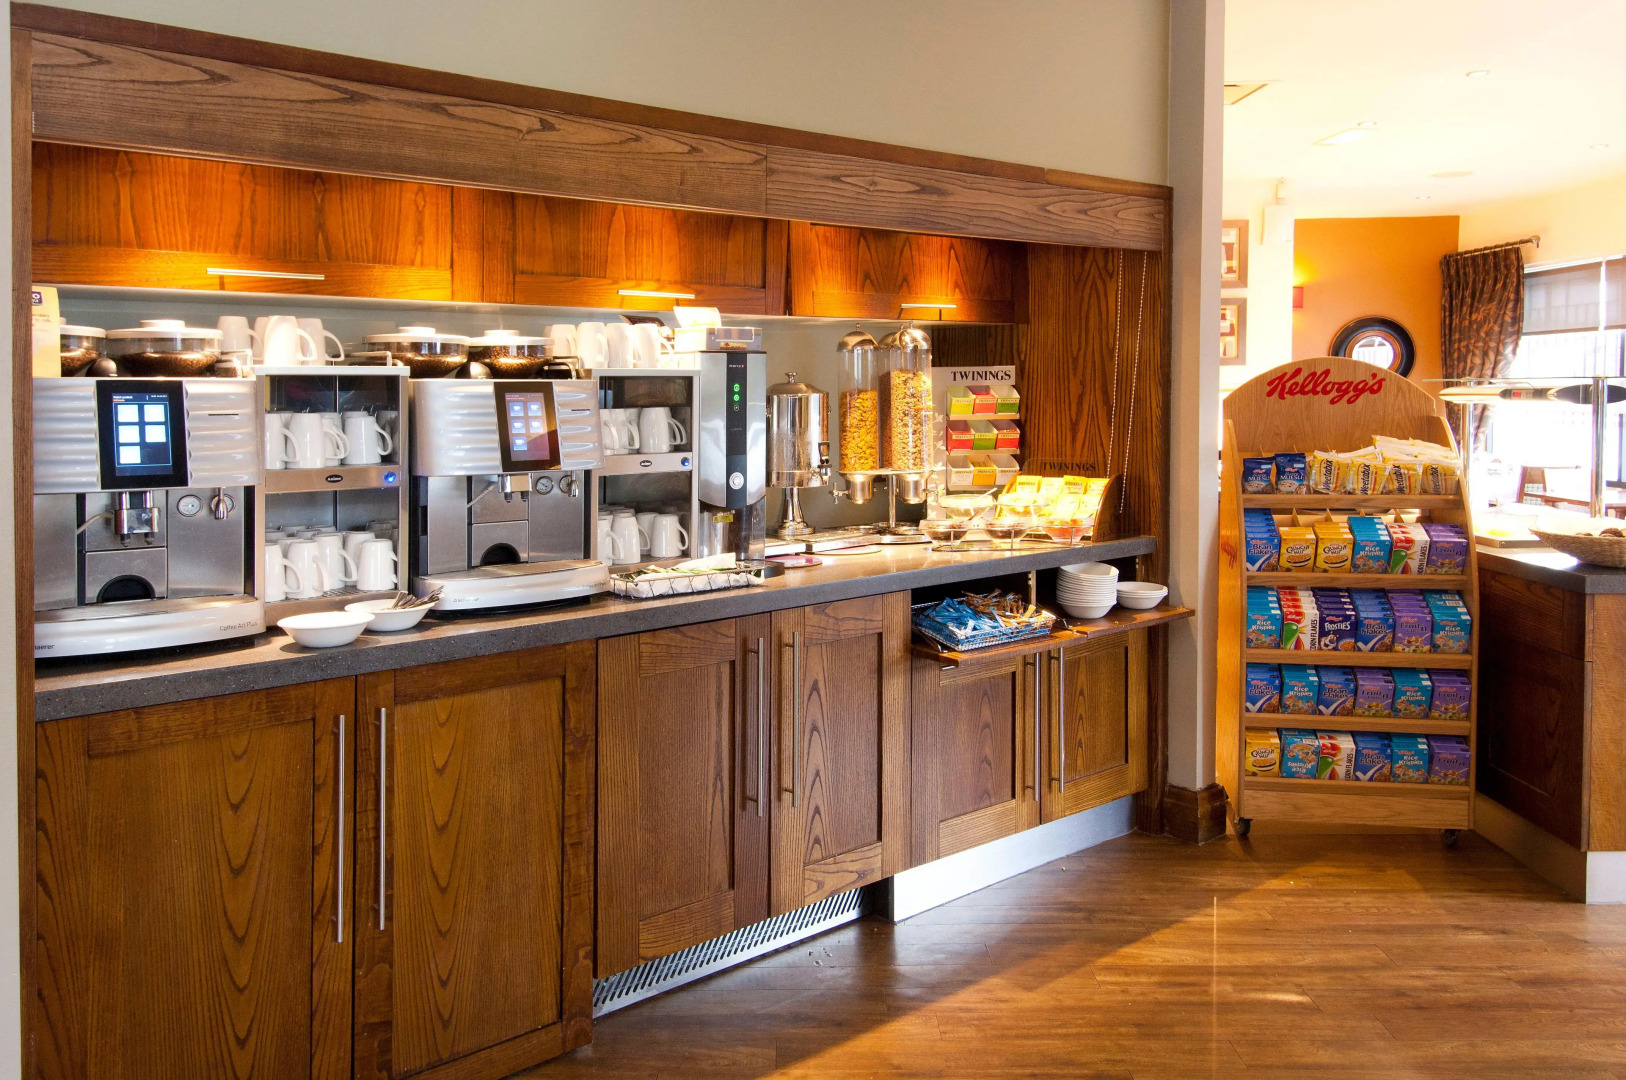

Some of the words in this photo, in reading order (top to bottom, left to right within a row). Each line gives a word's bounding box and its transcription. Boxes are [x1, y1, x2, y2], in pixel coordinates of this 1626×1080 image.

[951, 370, 1011, 382] TWININGS
[1266, 367, 1386, 405] Kellogg's
[1043, 462, 1096, 472] TWININGS
[1322, 459, 1333, 491] Weetabix
[1360, 463, 1370, 495] Weetabix
[1392, 464, 1405, 494] Weetabix
[1418, 546, 1427, 562] FLAKES
[1310, 619, 1318, 637] FLAKES
[1325, 622, 1350, 631] FROSTIES
[1345, 753, 1353, 768] FLAKES
